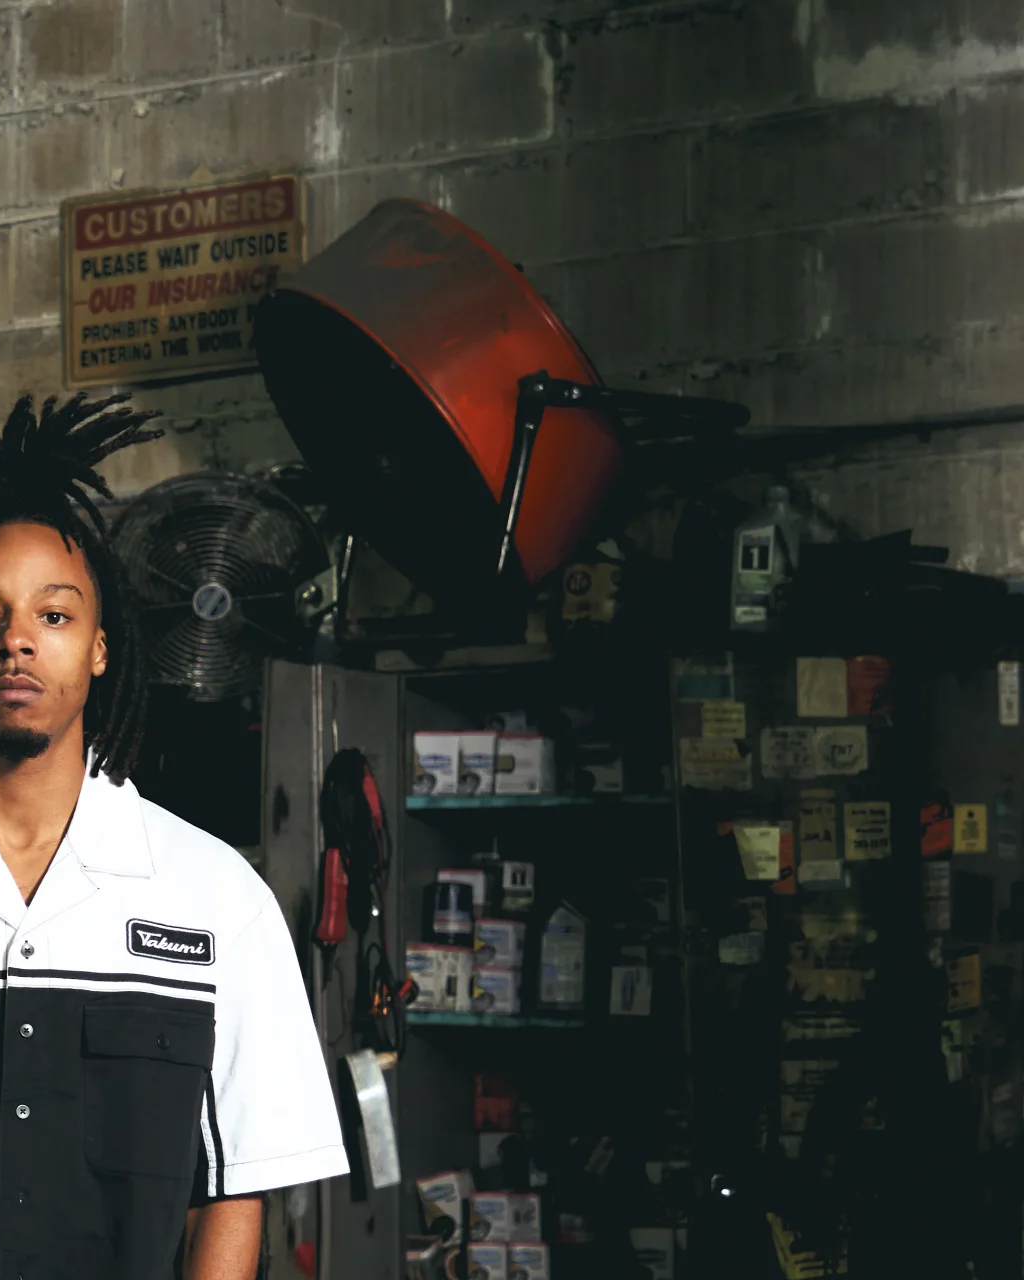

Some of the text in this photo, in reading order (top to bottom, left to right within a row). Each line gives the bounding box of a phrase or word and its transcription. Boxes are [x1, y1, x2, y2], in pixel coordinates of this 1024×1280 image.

[83, 186, 286, 242] CUSTOMERS
[81, 231, 289, 281] PLEASE WAIT OUTSIDE
[88, 283, 137, 315] OUR
[81, 317, 159, 344] PROHIBITS
[168, 307, 238, 333] ANYBODY
[80, 341, 152, 367] ENTERING
[160, 337, 189, 358] THE
[196, 330, 242, 353] WORK
[136, 929, 206, 955] Takumi
